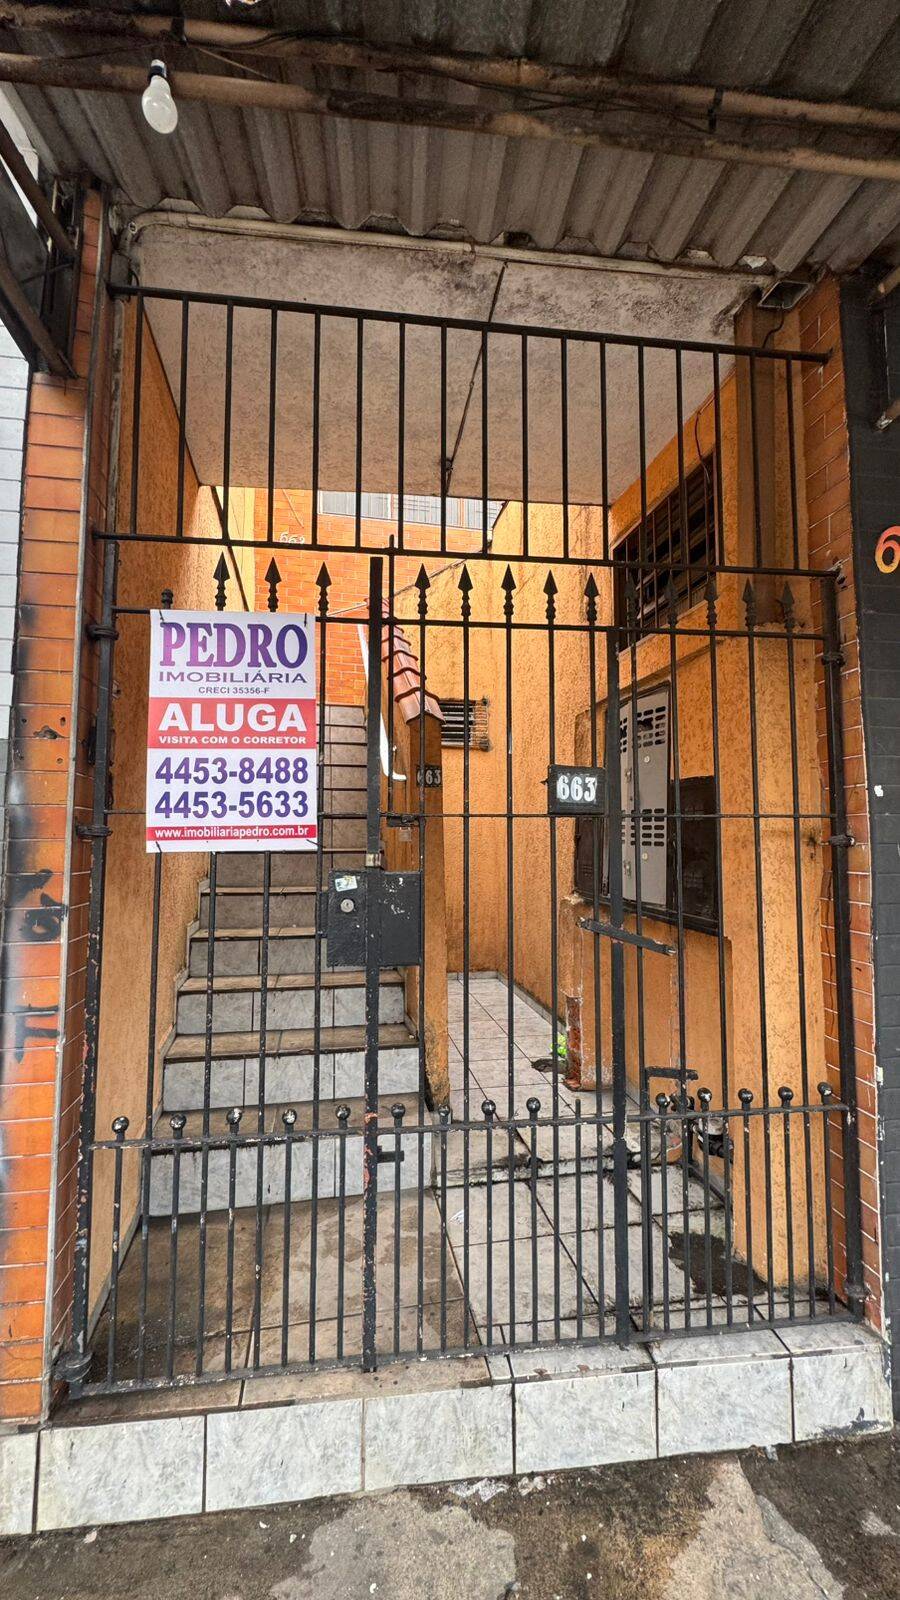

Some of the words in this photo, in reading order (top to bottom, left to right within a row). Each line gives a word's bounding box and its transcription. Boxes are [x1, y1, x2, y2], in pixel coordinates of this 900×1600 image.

[159, 622, 308, 669] PEDRO
[158, 670, 307, 684] IMOBILIÁRIA
[198, 686, 230, 694] CRECI
[232, 686, 270, 695] 35356-F
[158, 702, 307, 732] ALUGA
[158, 735, 198, 744] VISITA
[201, 735, 228, 744] COM
[231, 736, 240, 744] O
[243, 736, 307, 744] CORRETOR
[155, 756, 309, 785] 4453-8488
[557, 774, 597, 802] 663
[154, 790, 309, 819] 4453-5633
[154, 826, 309, 839] www.imobiliariapedro.com.br
